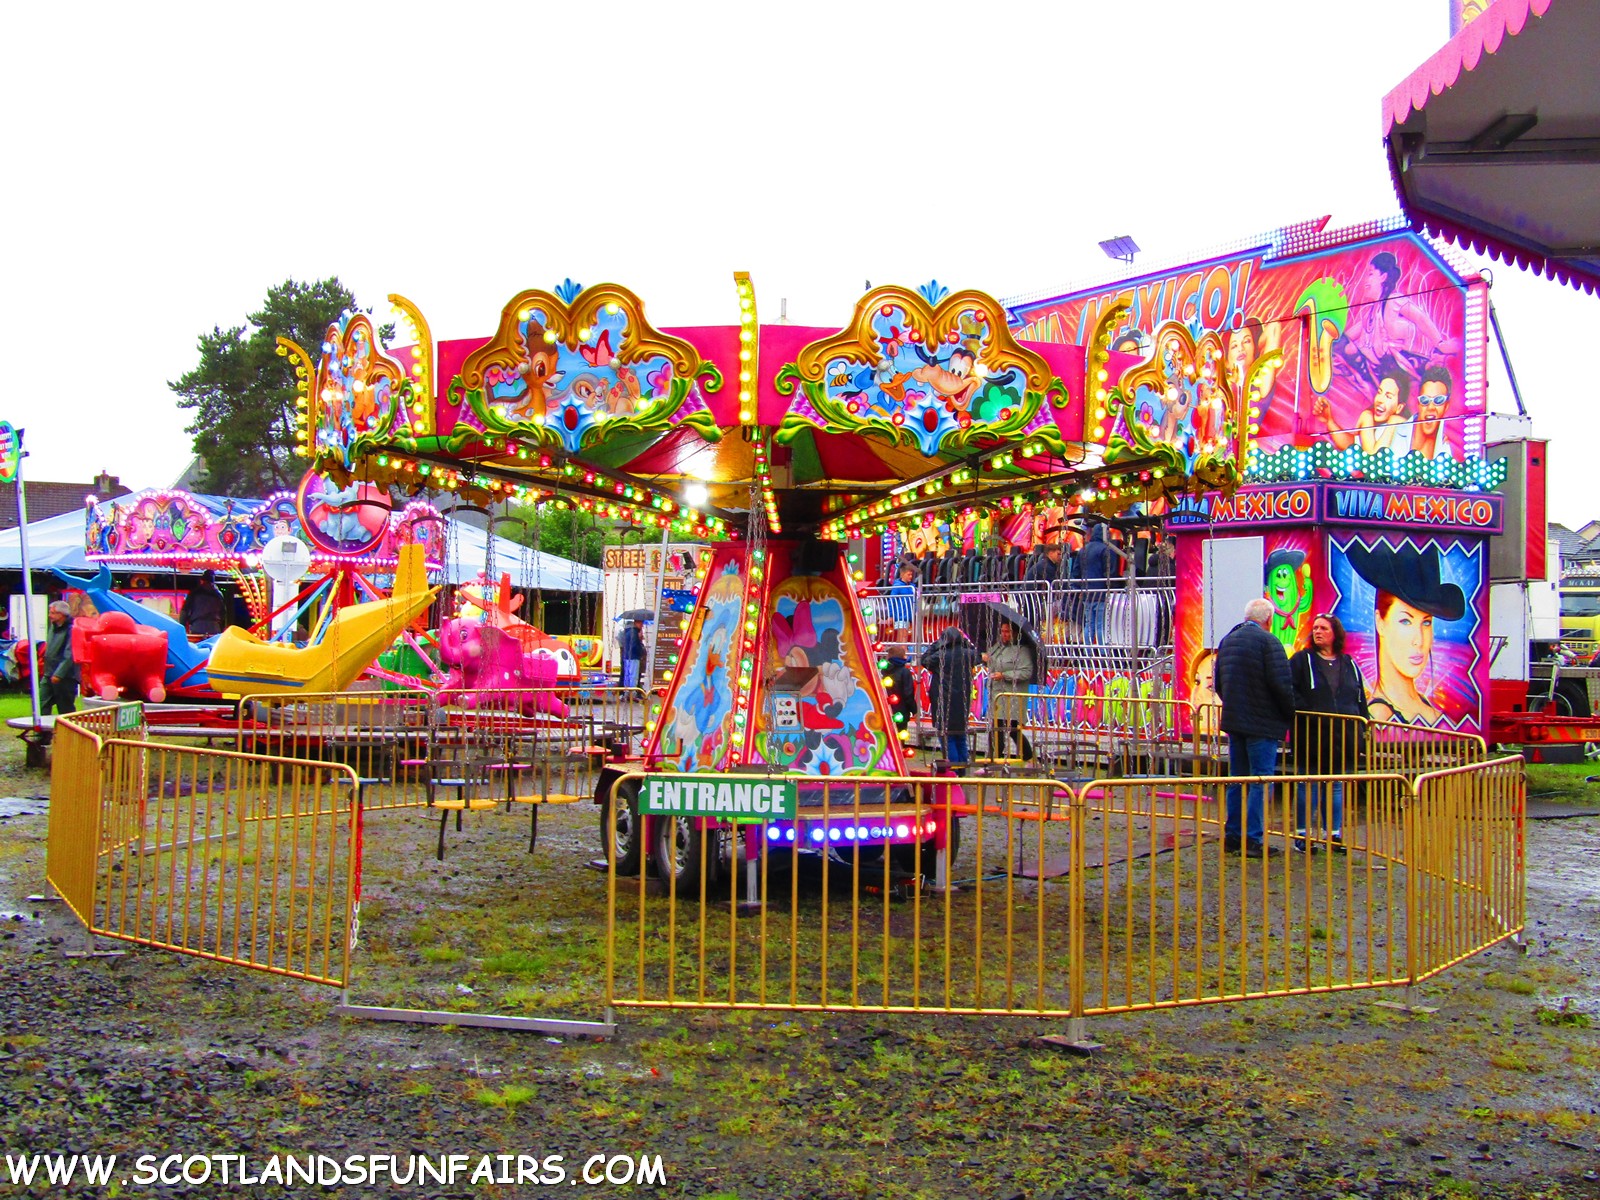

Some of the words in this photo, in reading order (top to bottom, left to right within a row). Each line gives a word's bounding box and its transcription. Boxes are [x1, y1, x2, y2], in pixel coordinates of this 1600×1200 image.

[1210, 489, 1312, 523] MEXICO
[1335, 489, 1384, 519] VIVA
[1384, 492, 1494, 526] MEXICO
[120, 706, 138, 727] EXIT
[649, 780, 786, 814] ENTRANCE
